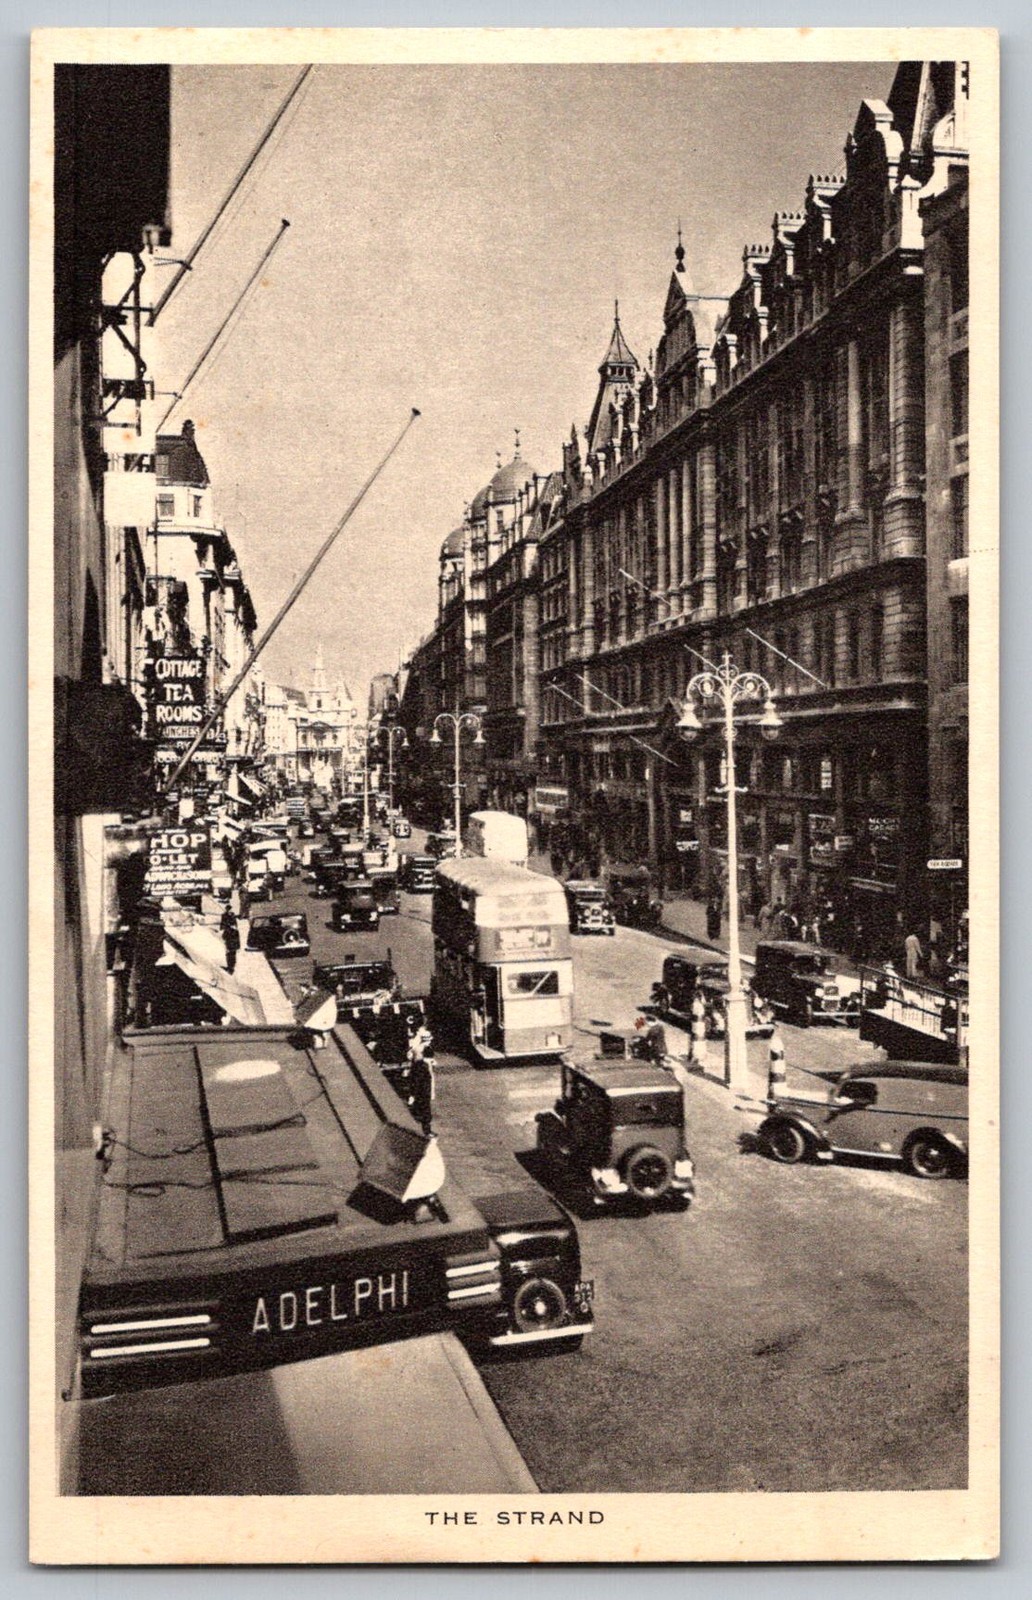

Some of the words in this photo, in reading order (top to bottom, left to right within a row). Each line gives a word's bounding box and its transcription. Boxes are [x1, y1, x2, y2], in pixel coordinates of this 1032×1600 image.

[155, 658, 203, 679] COTTAGE
[163, 683, 195, 701] TEA
[156, 704, 203, 722] ROOMS
[252, 1270, 409, 1333] ADELPHI
